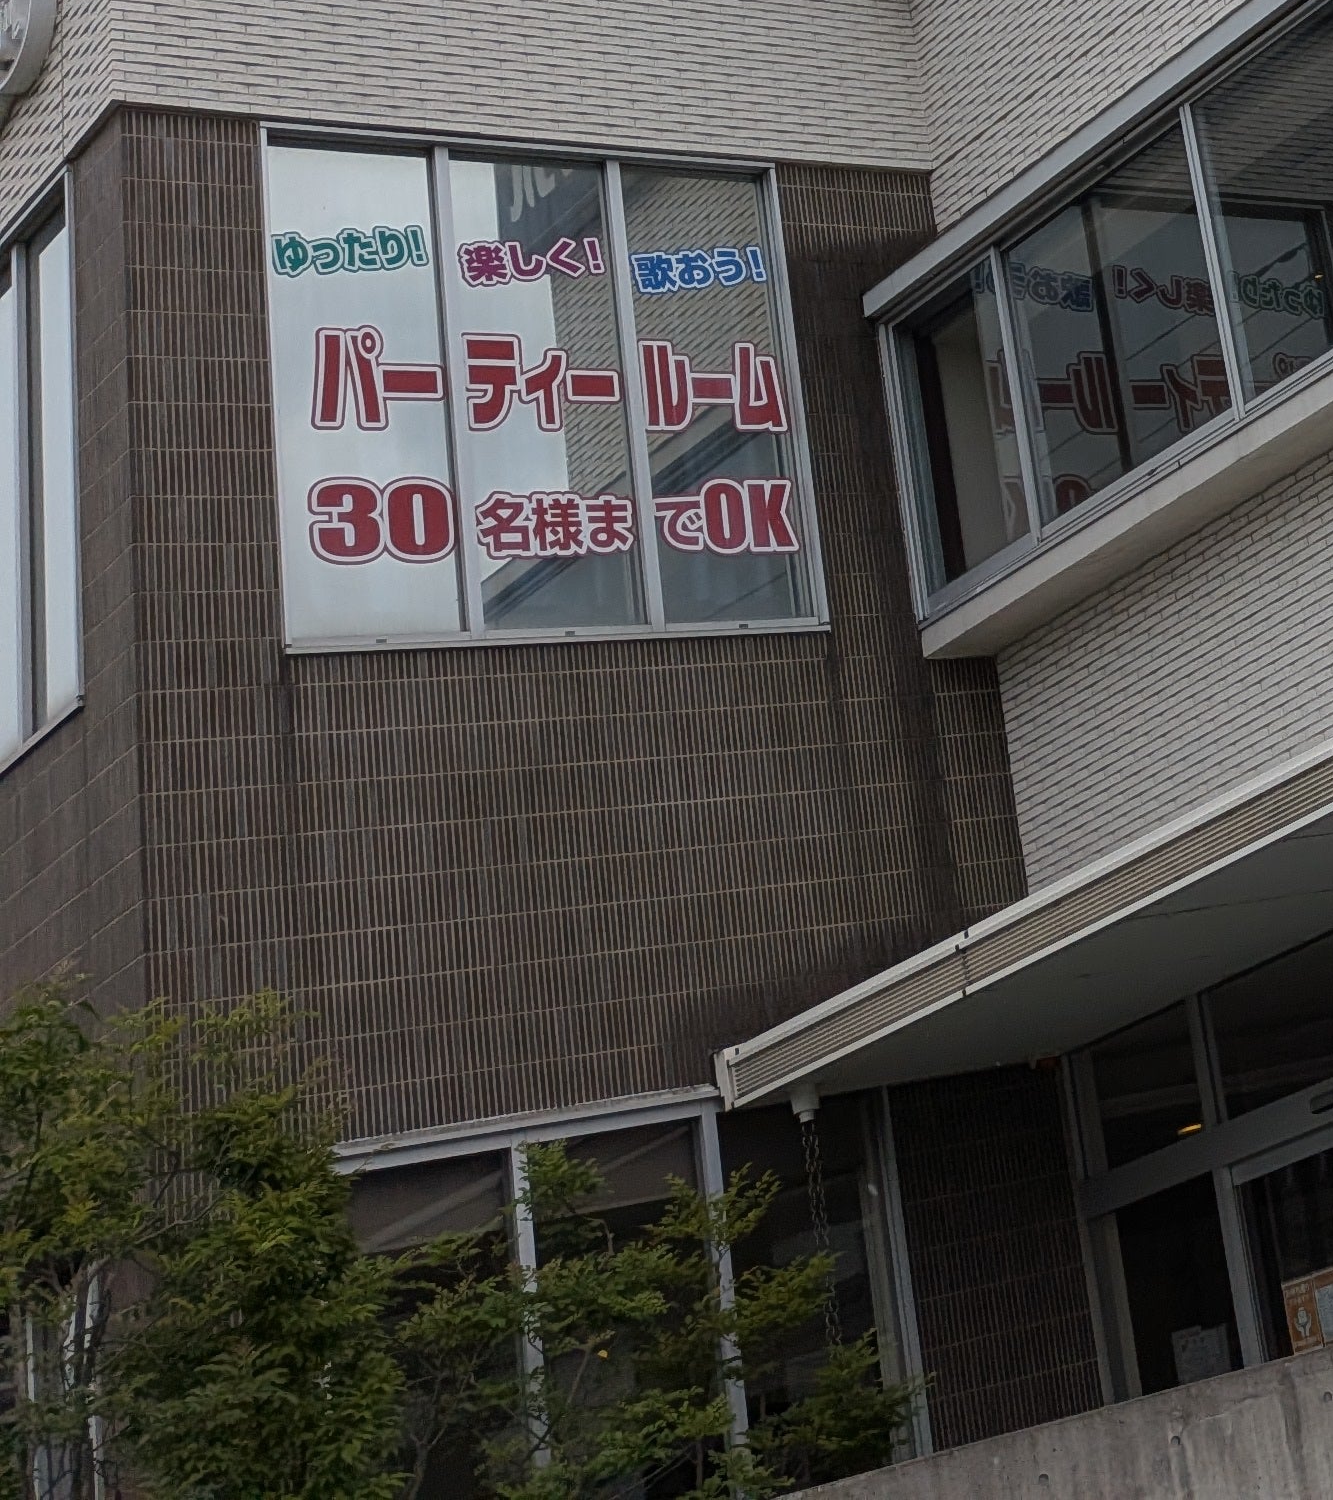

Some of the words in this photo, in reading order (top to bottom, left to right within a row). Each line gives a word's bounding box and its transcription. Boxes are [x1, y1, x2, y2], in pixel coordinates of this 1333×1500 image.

[272, 225, 430, 276] ゆったり!
[458, 237, 607, 287] 楽しく!
[631, 245, 768, 295] 歌おう!
